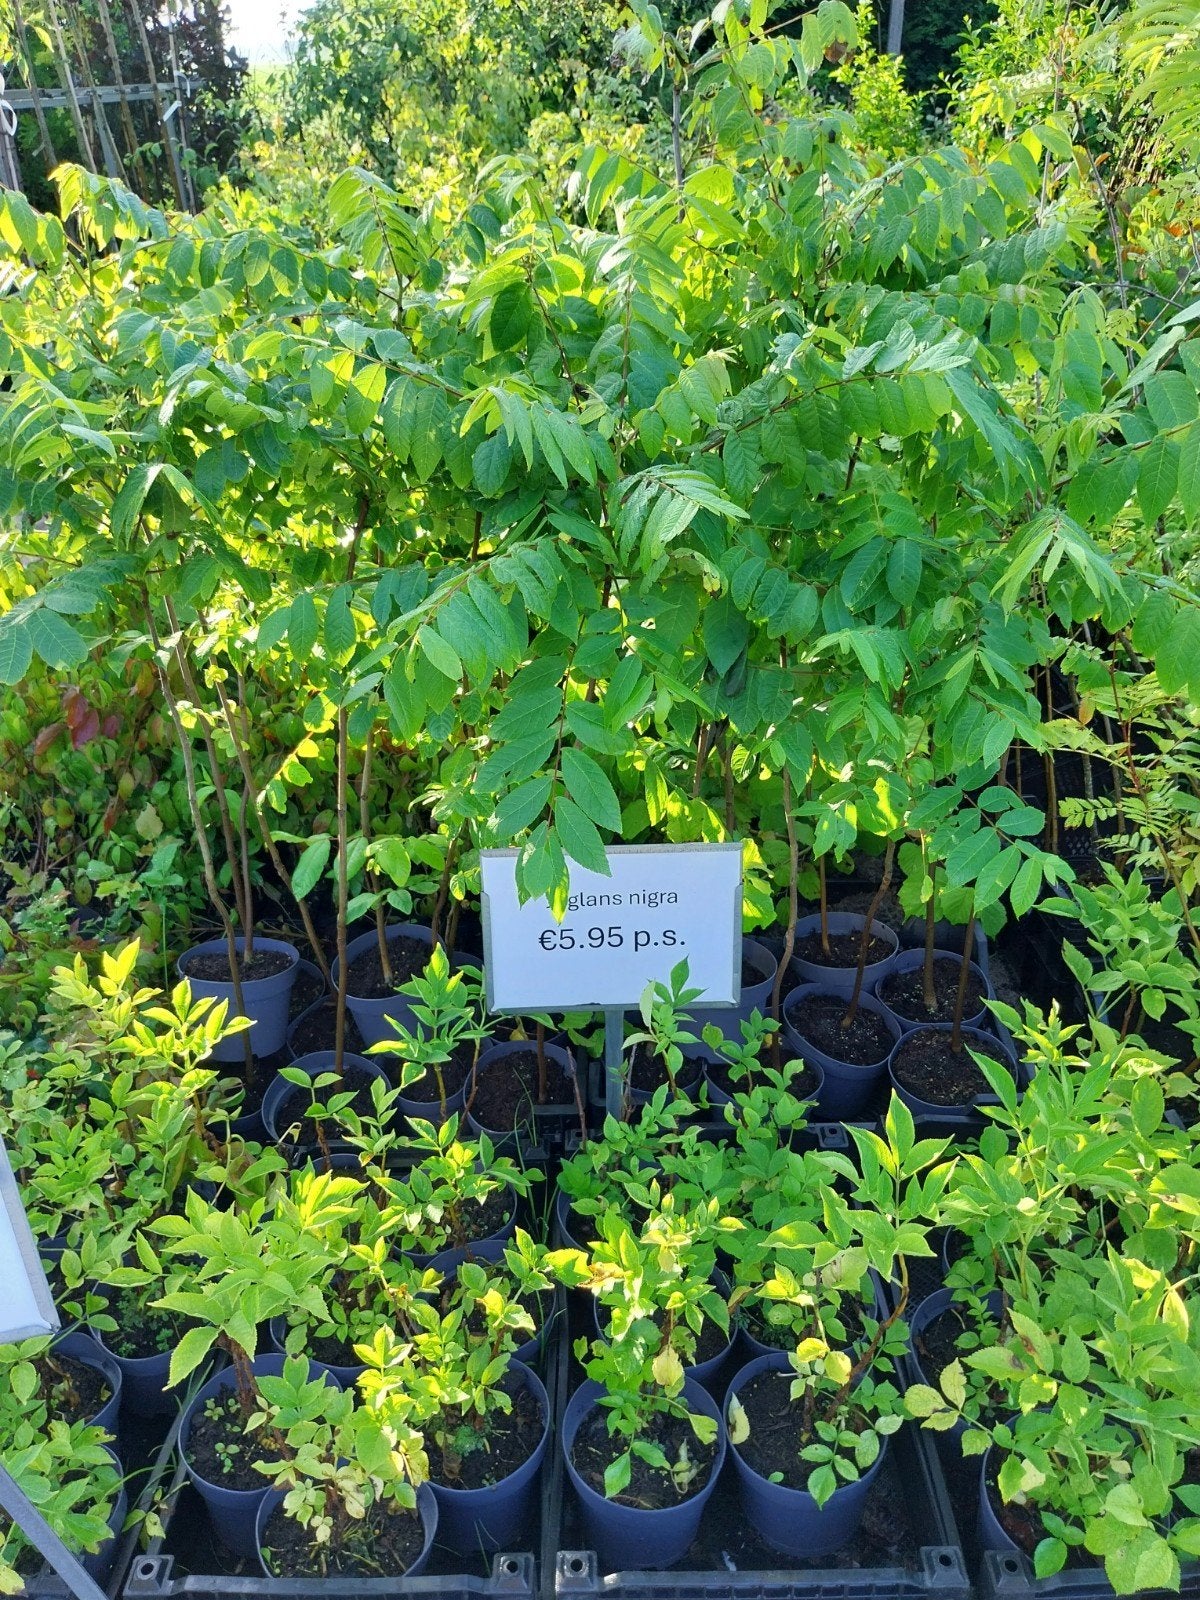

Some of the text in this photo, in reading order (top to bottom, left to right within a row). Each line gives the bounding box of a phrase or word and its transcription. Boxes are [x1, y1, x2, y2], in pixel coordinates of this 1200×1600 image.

[546, 889, 678, 912] glans nigra
[538, 926, 686, 952] €5.95 p.s.
